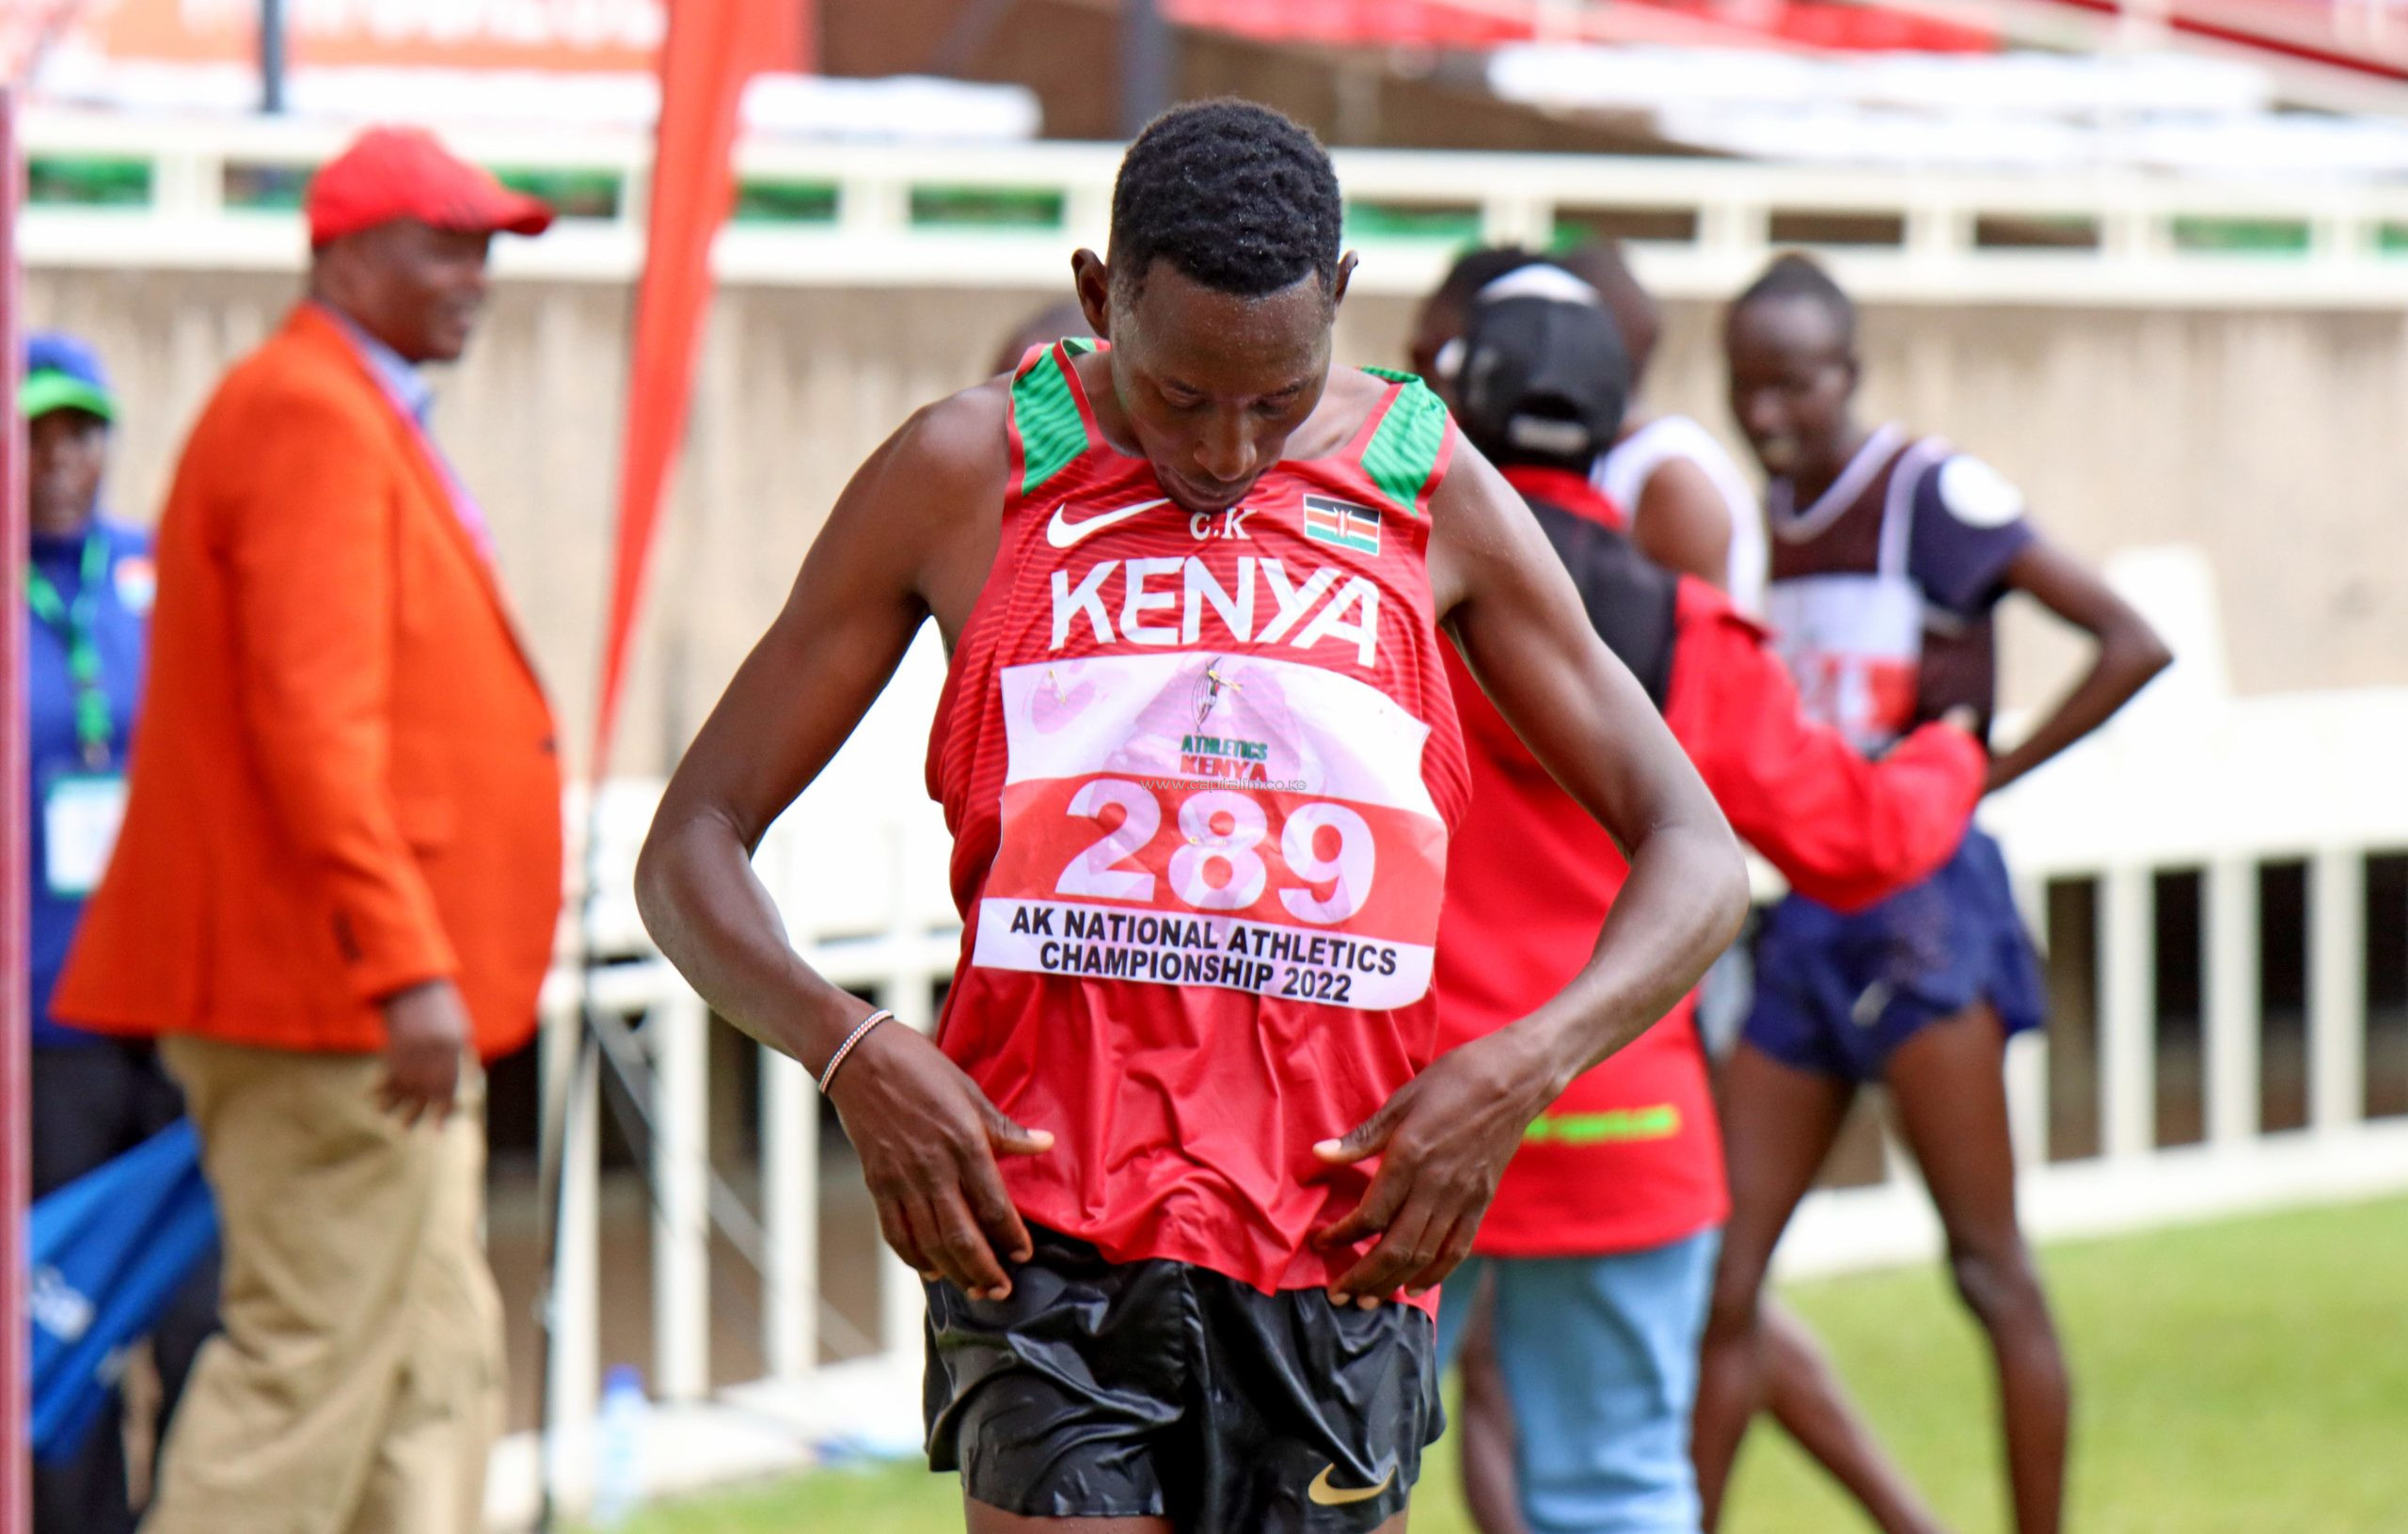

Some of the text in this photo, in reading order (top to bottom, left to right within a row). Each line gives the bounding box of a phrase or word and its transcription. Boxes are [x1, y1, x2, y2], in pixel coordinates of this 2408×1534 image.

[1048, 555, 1380, 668] KENYA
[1180, 735, 1268, 760] ATHLETICS
[1180, 754, 1267, 783] KENYA
[1054, 778, 1376, 925] 289
[1010, 906, 1397, 975] AK NATIONAL ATHLETICS
[1040, 941, 1352, 1003] CHAMPIONSHIP 2022
